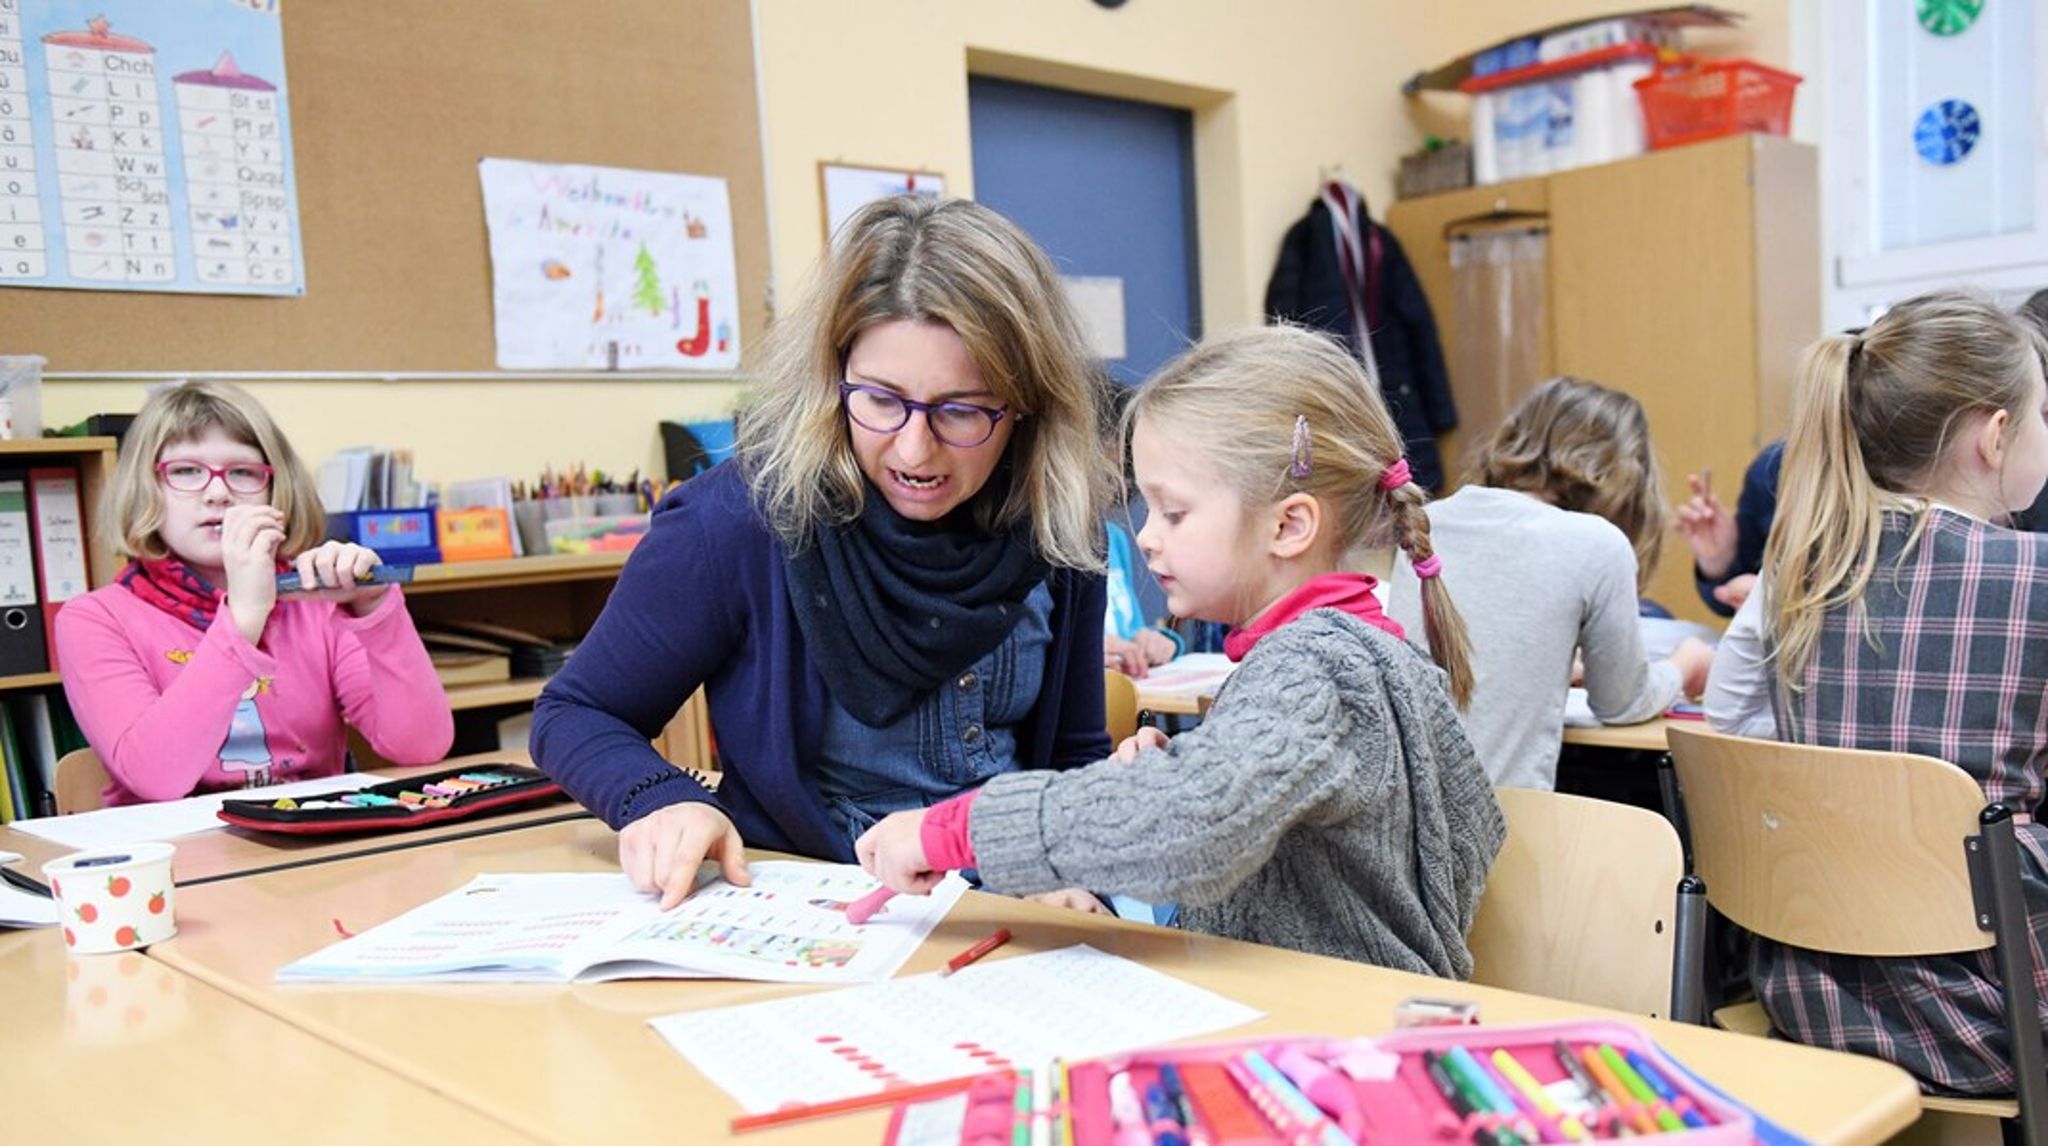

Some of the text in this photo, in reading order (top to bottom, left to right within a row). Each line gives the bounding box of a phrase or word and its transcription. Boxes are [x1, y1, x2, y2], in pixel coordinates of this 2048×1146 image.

[108, 80, 120, 96] L
[111, 106, 150, 126] P p
[113, 131, 152, 148] K k
[5, 156, 17, 168] u
[115, 157, 158, 173] W w
[122, 207, 158, 225] Z z
[14, 235, 26, 247] e
[124, 233, 135, 249] T
[17, 261, 29, 274] a
[126, 259, 165, 275] N n
[249, 263, 263, 279] C
